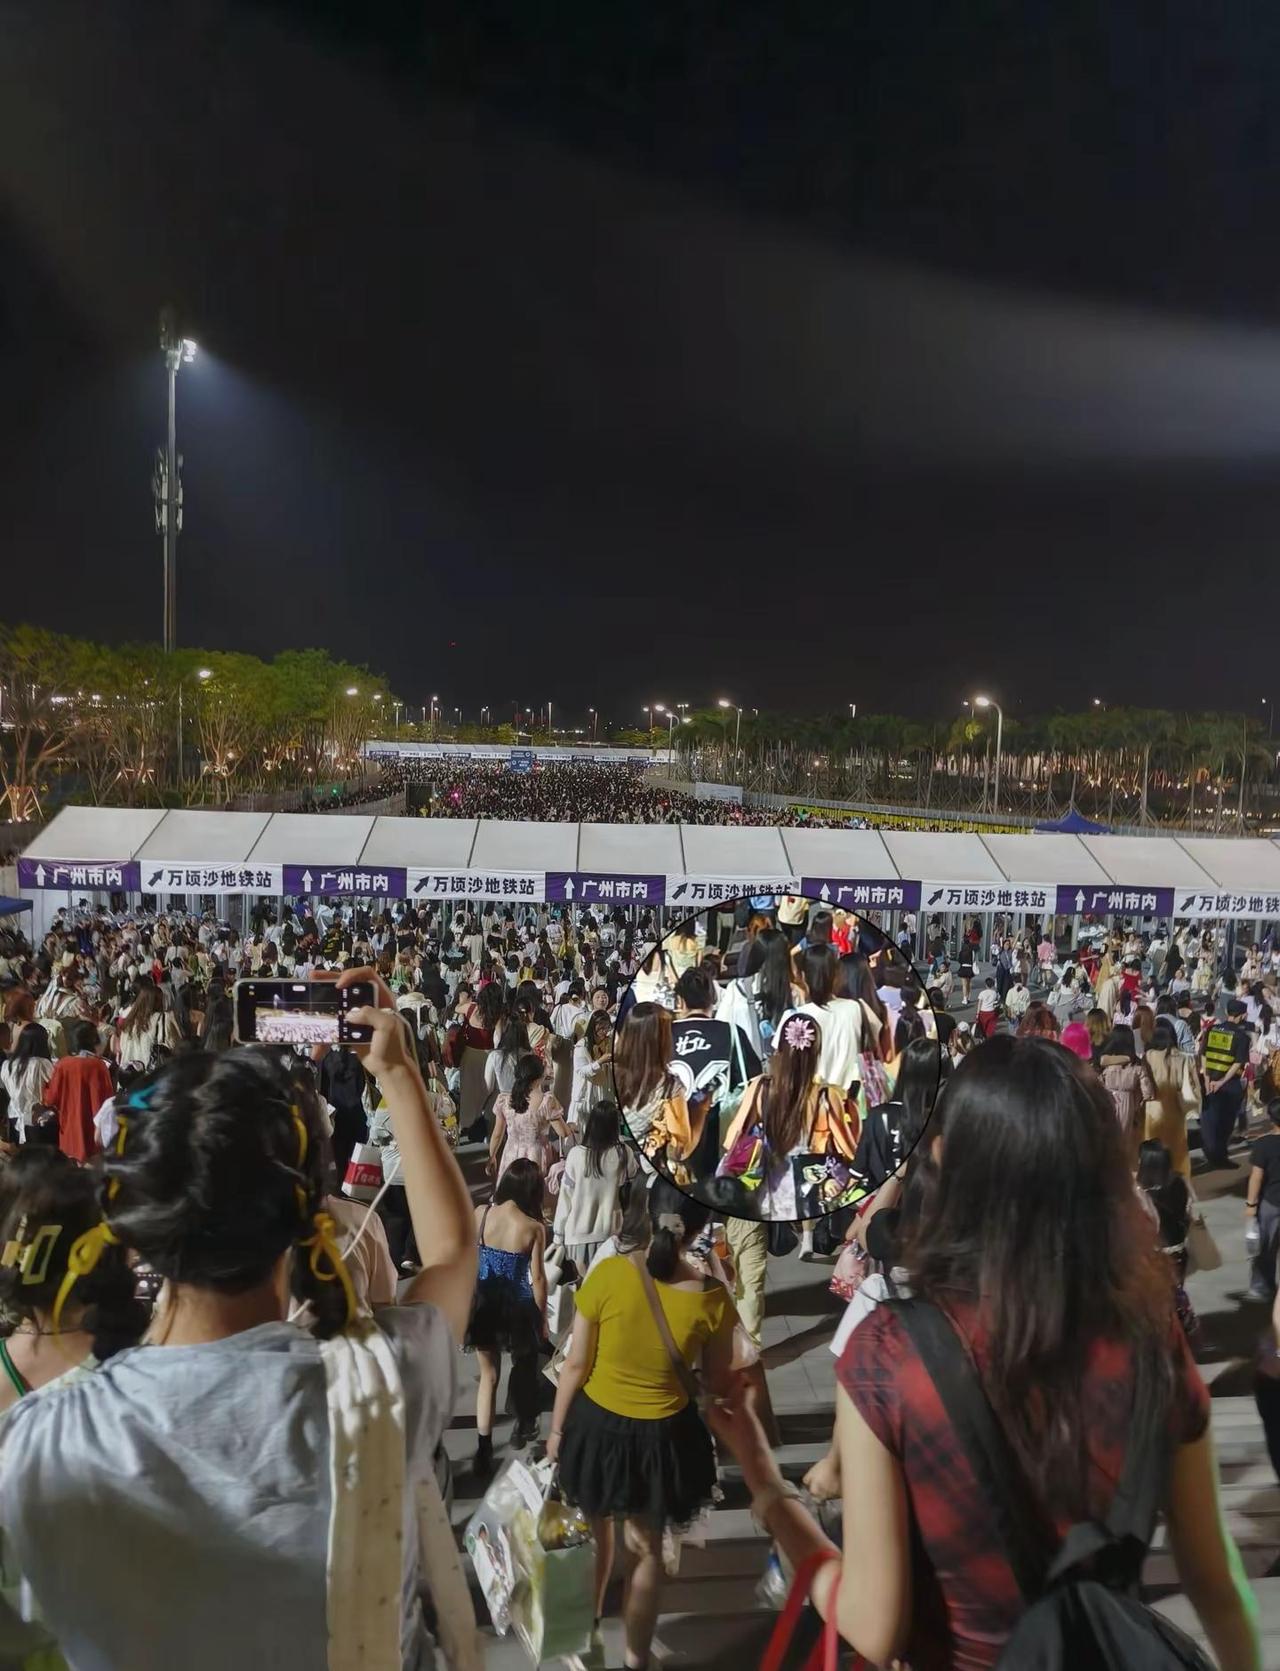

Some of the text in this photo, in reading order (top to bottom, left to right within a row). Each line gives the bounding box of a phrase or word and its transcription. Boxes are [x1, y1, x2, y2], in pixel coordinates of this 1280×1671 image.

[53, 868, 121, 886] 广州市内
[168, 870, 272, 888] 万顷沙地铁站
[320, 872, 388, 891] 广州市内
[433, 876, 535, 895] 万顷沙地铁站
[581, 881, 647, 898] 广州市内
[838, 885, 903, 904] 广州市内
[947, 889, 1046, 907] 万顷沙地铁站
[1091, 891, 1156, 910] 广州市内
